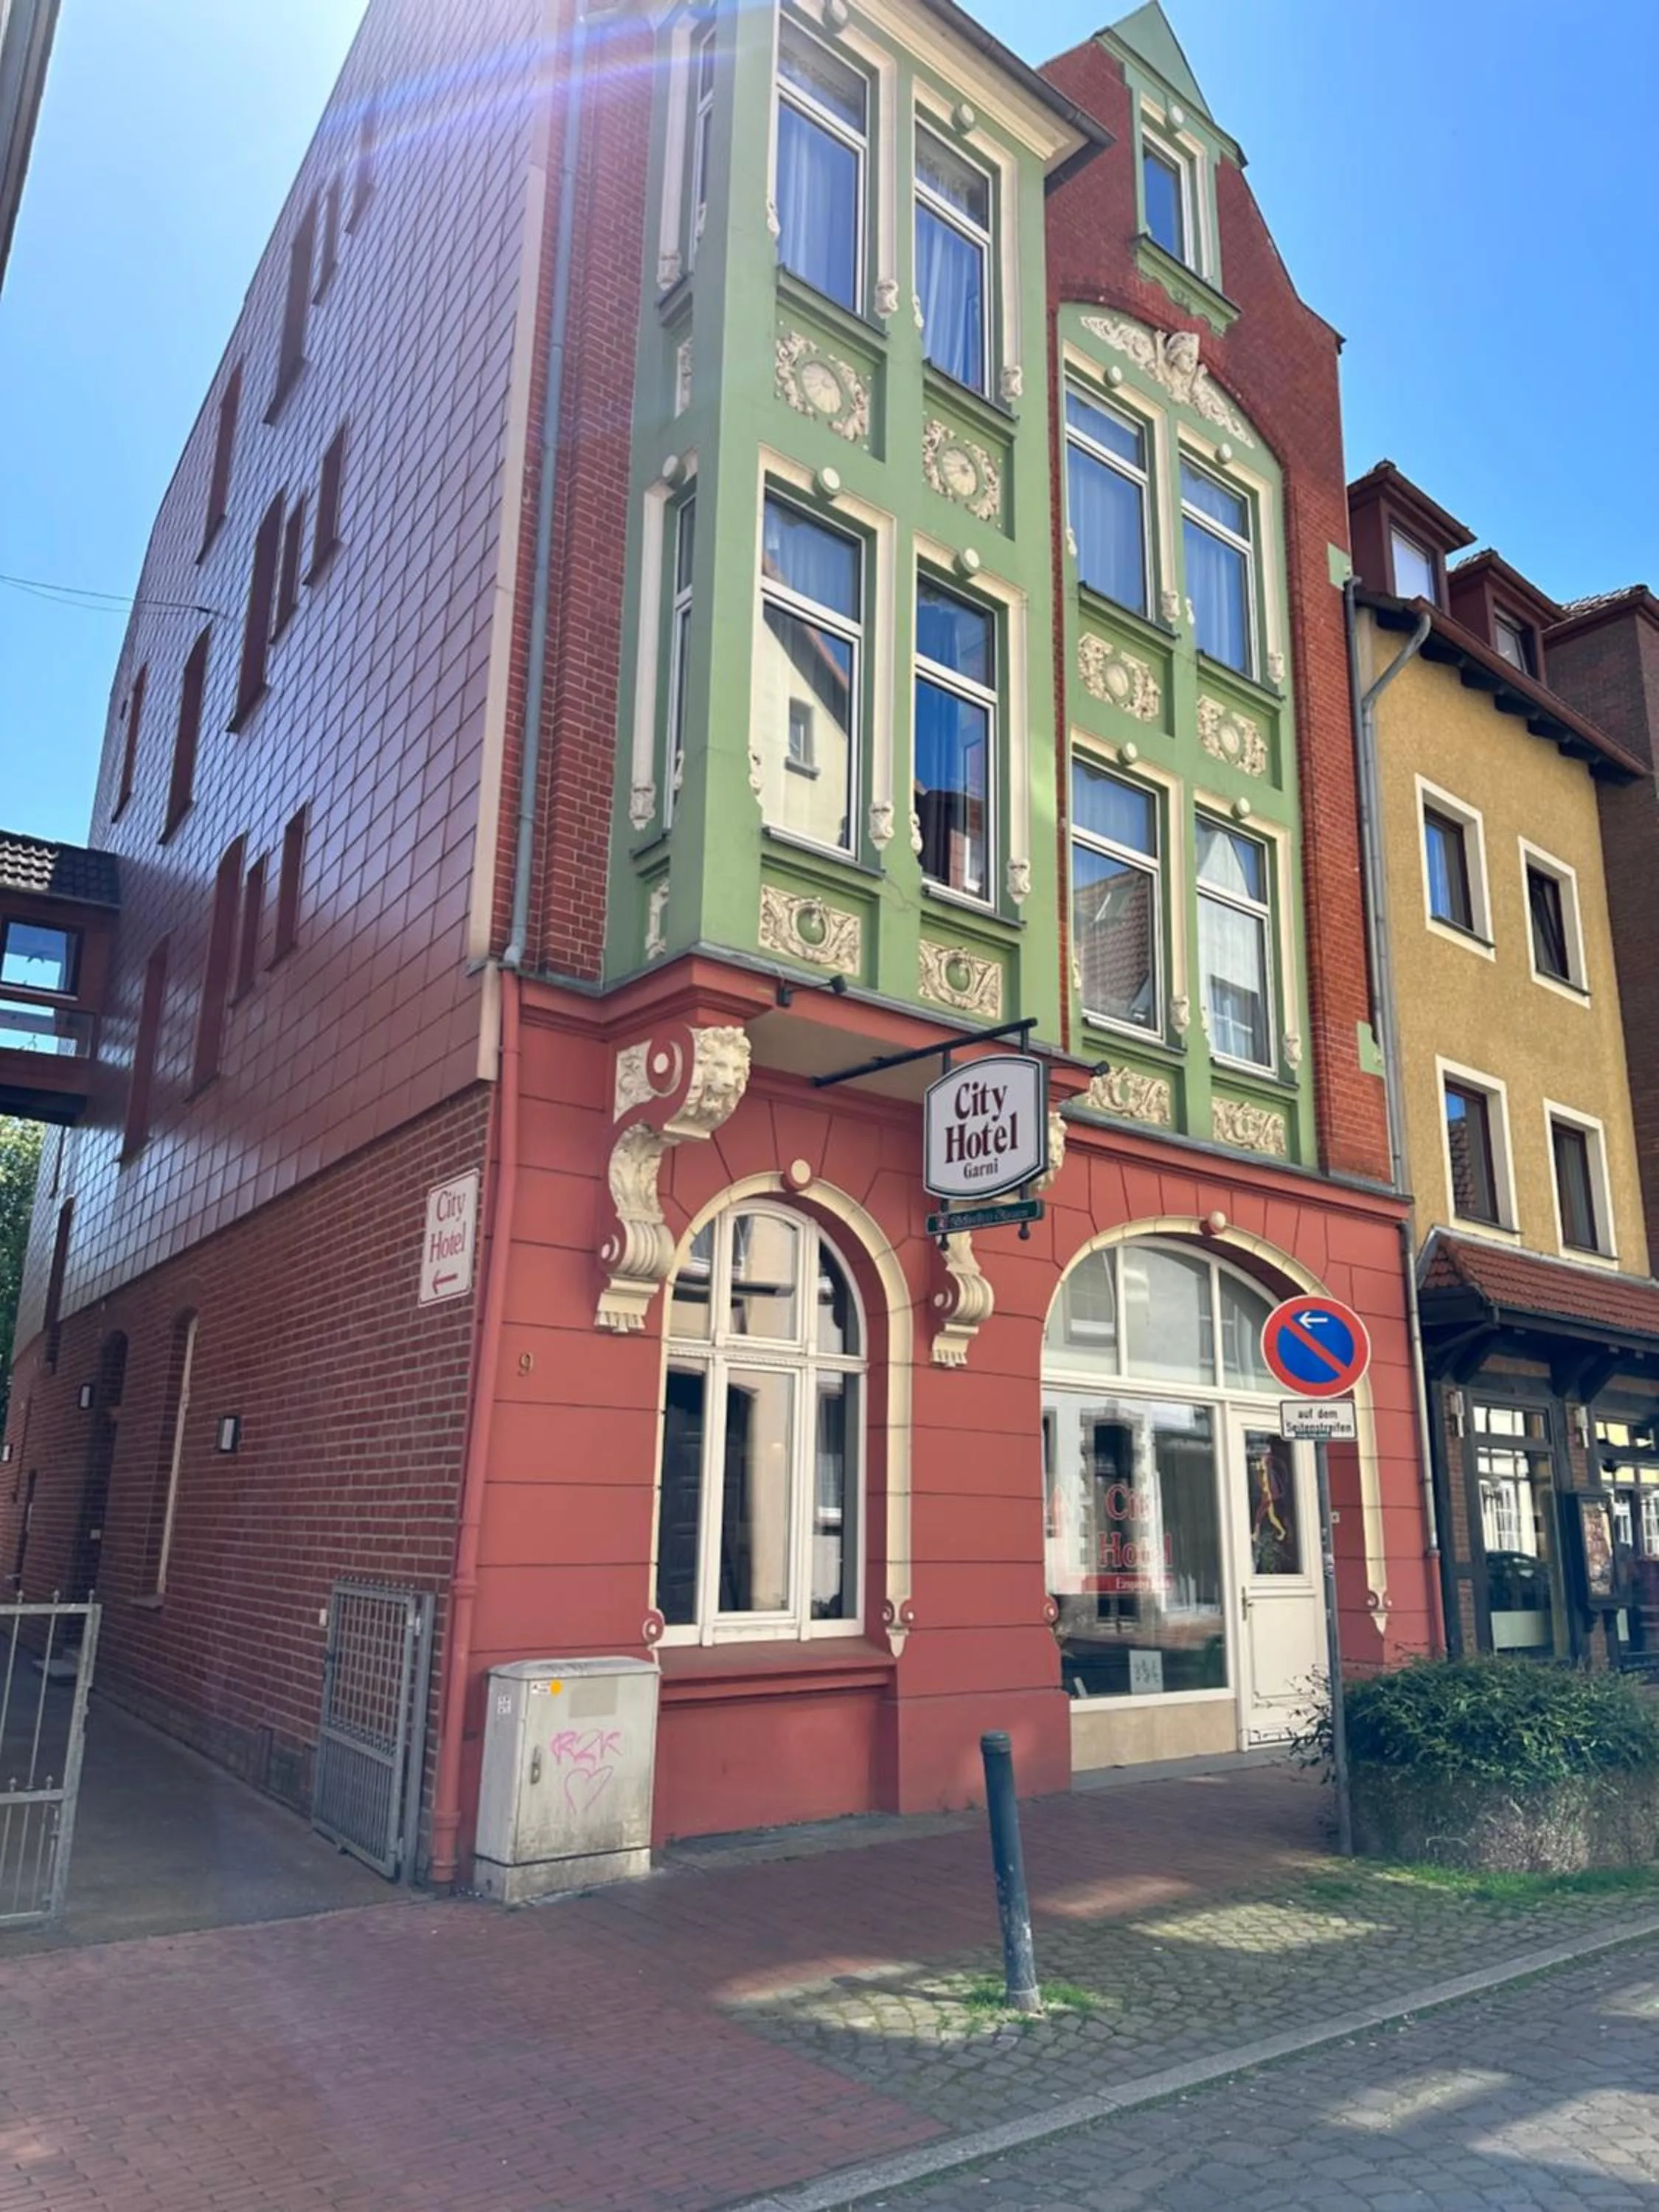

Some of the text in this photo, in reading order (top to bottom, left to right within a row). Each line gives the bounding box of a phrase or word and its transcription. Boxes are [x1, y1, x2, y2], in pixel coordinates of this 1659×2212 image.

[953, 1081, 1008, 1121] City
[945, 1111, 1018, 1164] Hotel
[963, 1158, 998, 1180] Garni
[437, 1190, 466, 1222] City
[429, 1221, 466, 1263] Hotel
[518, 1352, 532, 1377] 9
[1285, 1420, 1352, 1432] Seitenstreifen
[1298, 1408, 1338, 1419] auf dem
[1105, 1484, 1155, 1523] Cit
